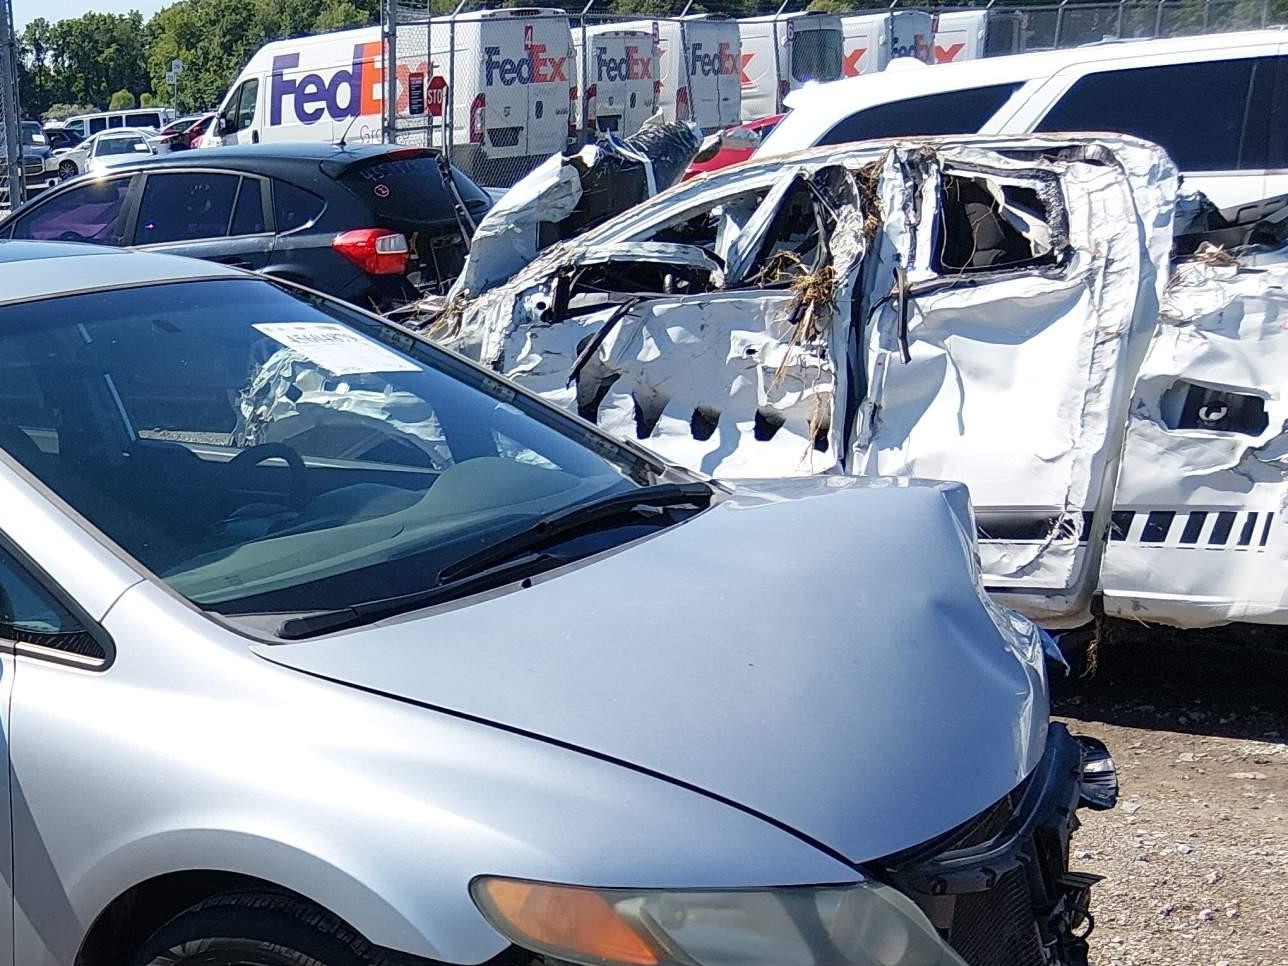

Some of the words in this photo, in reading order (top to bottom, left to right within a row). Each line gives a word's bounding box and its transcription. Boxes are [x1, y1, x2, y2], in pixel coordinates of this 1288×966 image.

[525, 28, 533, 49] 4
[787, 21, 794, 39] 6
[485, 44, 569, 86] FedEx
[596, 46, 652, 82] FedEx
[691, 42, 741, 77] FedEx
[427, 89, 443, 105] STO
